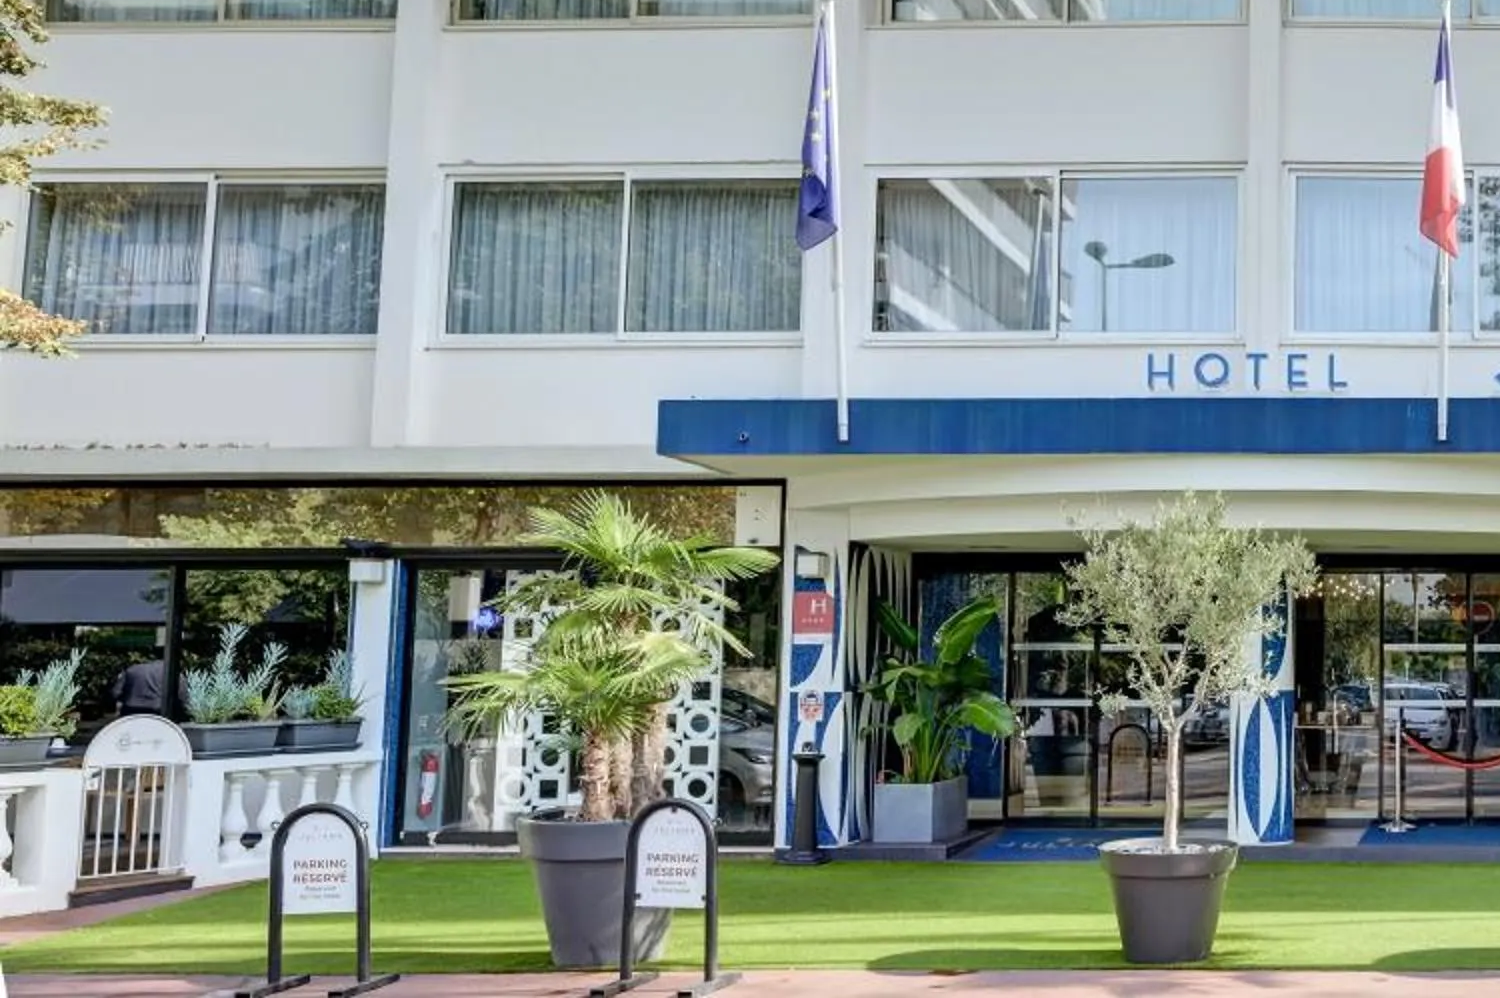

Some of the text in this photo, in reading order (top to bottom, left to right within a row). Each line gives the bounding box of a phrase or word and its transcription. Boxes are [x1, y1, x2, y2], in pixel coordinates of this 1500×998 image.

[1147, 352, 1349, 390] HOTEL
[810, 598, 827, 615] H
[292, 859, 348, 870] PARKING
[646, 852, 699, 863] PARKING
